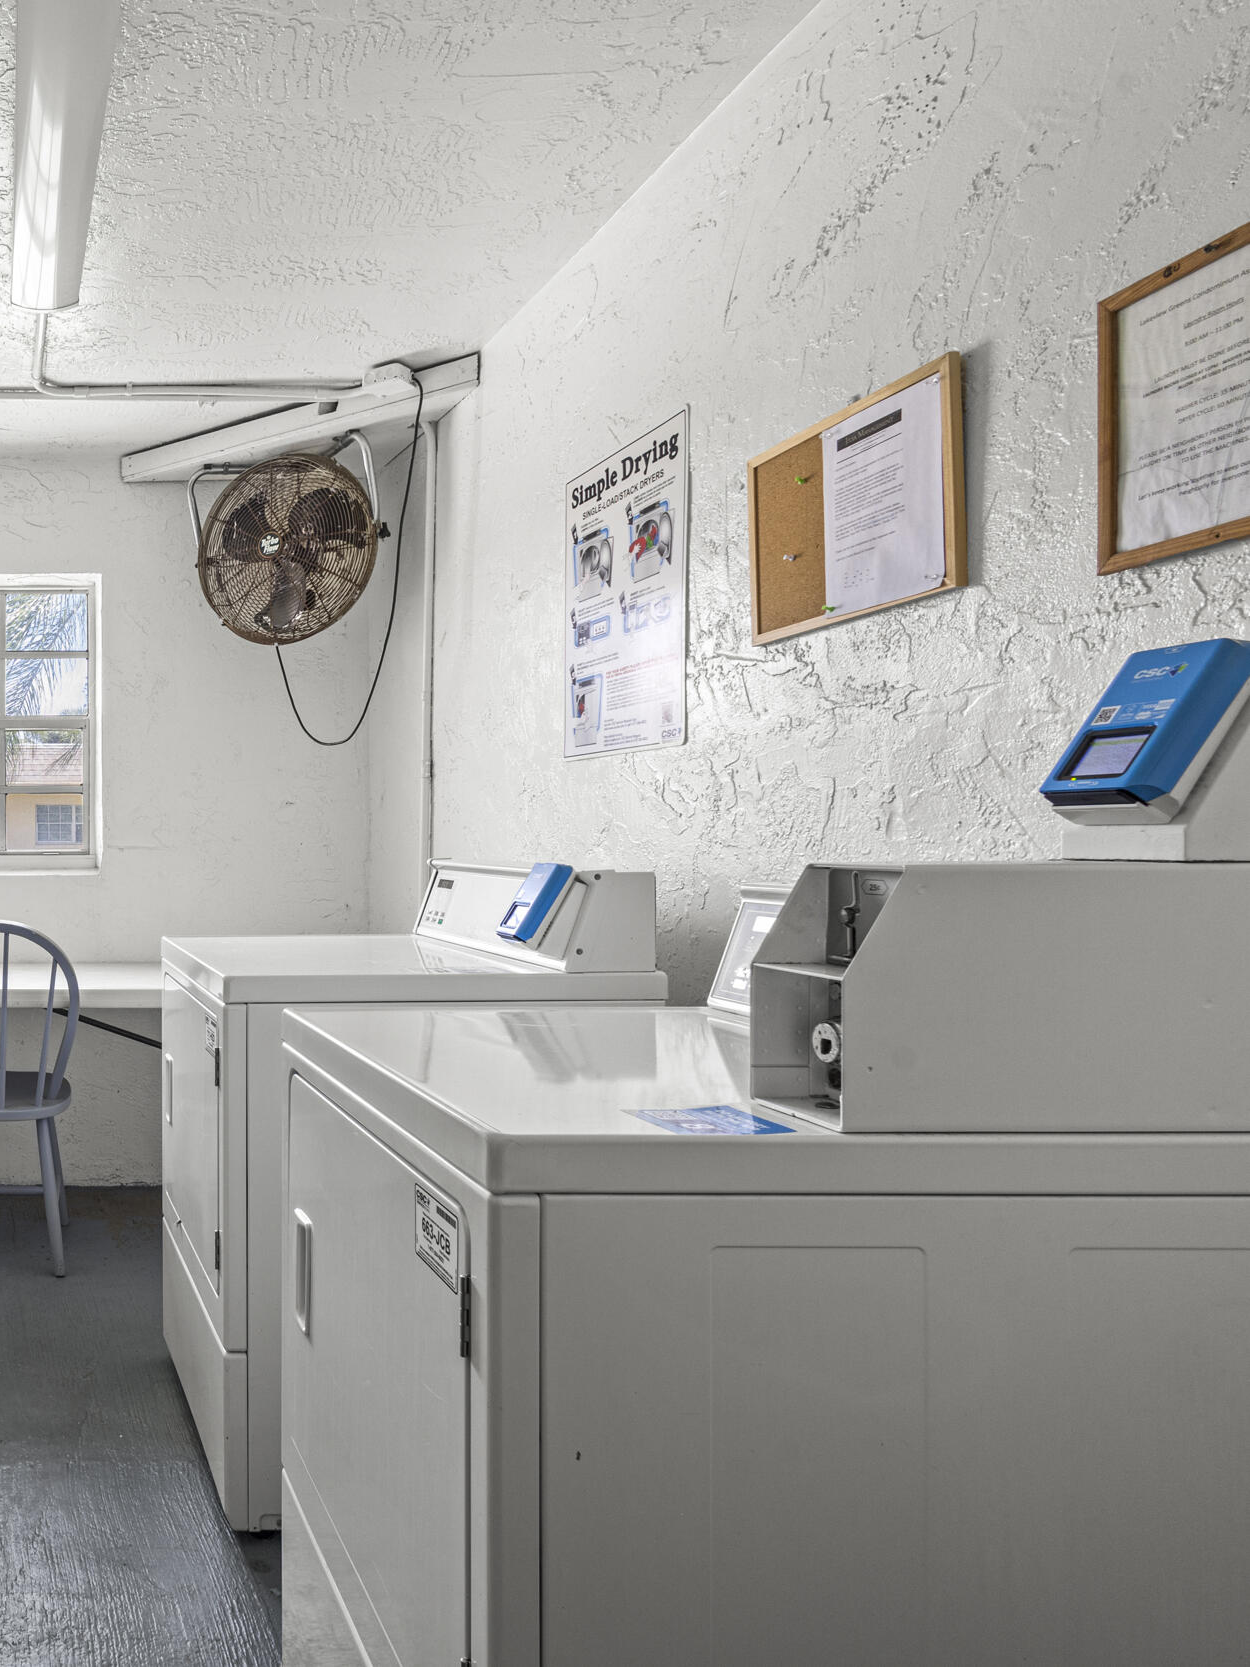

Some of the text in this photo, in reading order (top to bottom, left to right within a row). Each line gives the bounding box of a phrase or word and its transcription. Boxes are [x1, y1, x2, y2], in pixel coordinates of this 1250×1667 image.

[571, 467, 618, 509] Simple
[621, 432, 678, 484] Drying
[640, 469, 664, 494] DRYERS
[1133, 665, 1171, 680] CSC
[662, 728, 677, 738] CSC
[422, 1217, 450, 1255] 663-JCB
